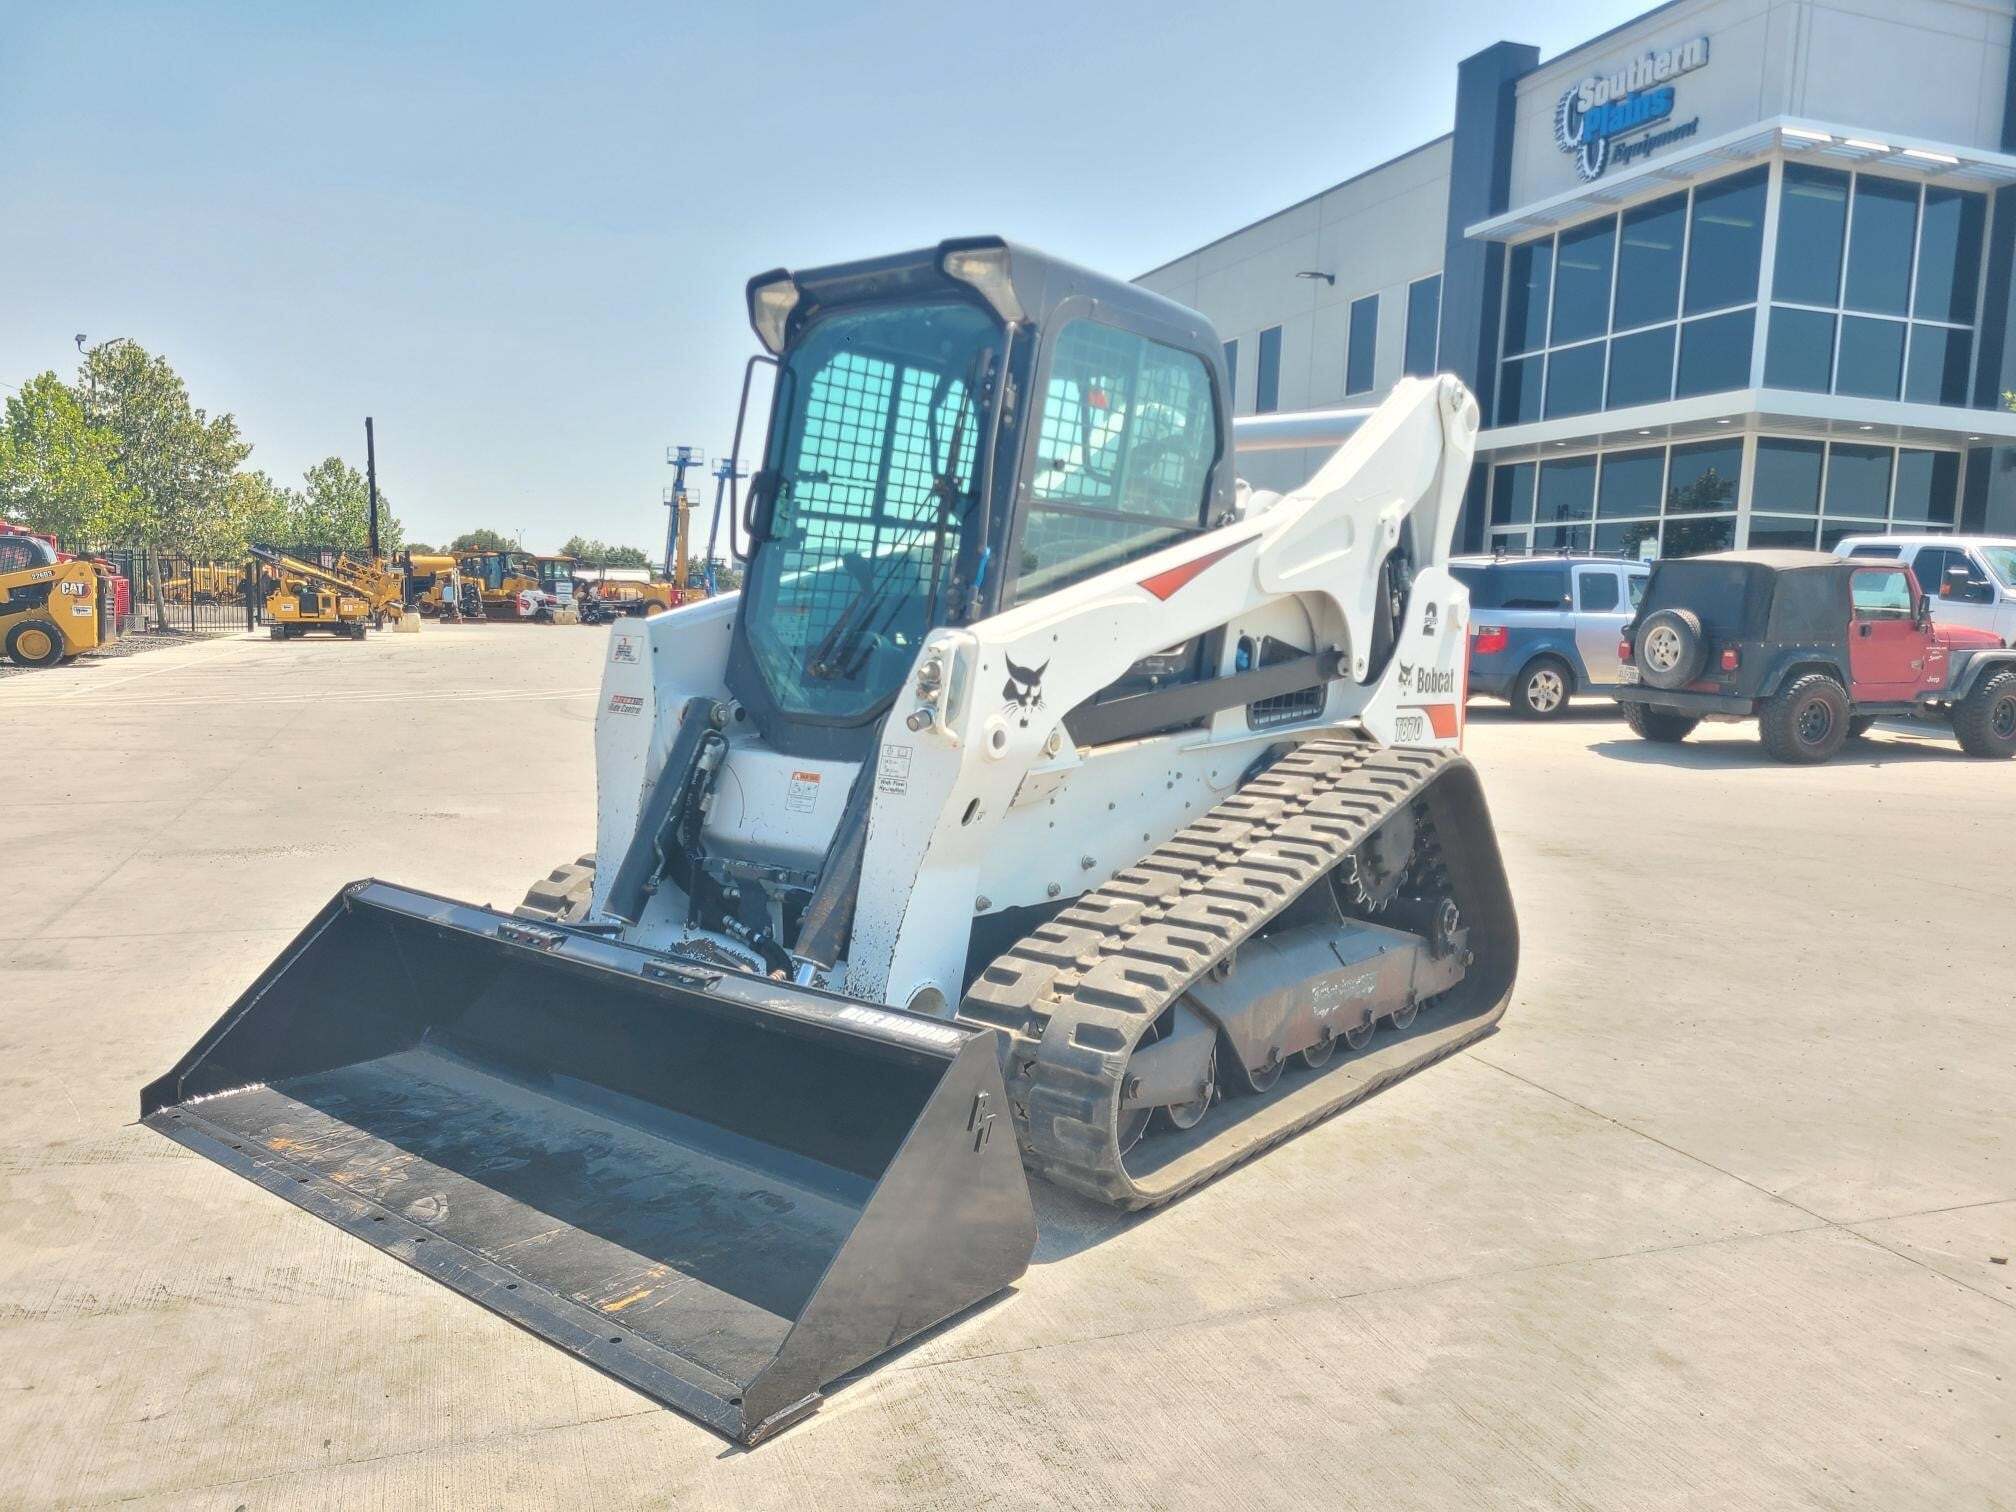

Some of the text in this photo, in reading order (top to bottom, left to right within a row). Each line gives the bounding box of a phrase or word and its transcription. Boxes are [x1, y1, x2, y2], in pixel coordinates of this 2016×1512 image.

[1576, 36, 1709, 113] Southern
[1583, 86, 1675, 145] Plains
[1610, 116, 1699, 165] Equipment
[61, 582, 85, 596] CAT
[1417, 667, 1454, 694] Bobcat
[1394, 716, 1423, 742] T870
